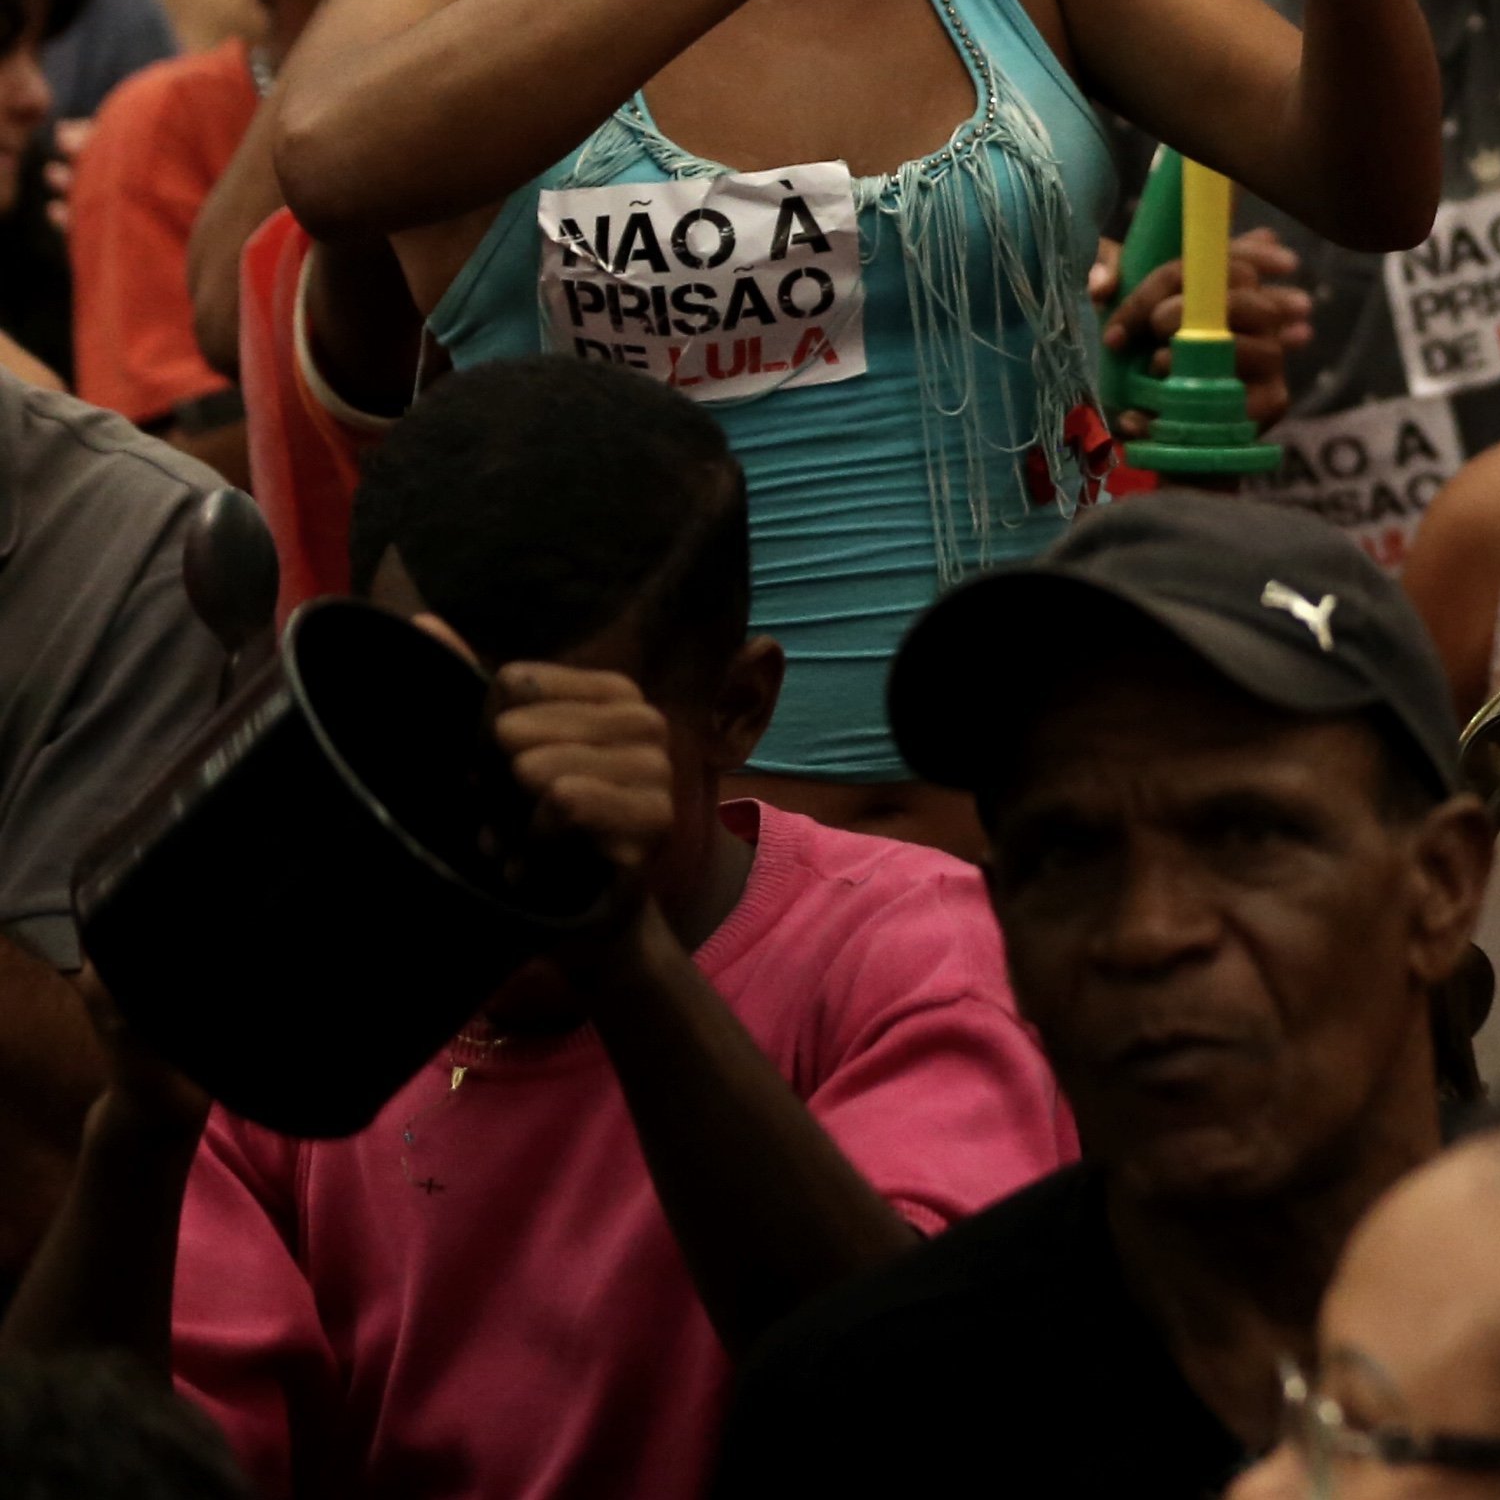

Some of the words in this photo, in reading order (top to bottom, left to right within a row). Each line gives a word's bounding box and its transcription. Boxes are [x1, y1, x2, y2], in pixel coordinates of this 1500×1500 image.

[559, 199, 736, 274] NÃO
[770, 179, 832, 262] À
[562, 264, 835, 337] PRISÃO
[667, 325, 840, 388] LULA
